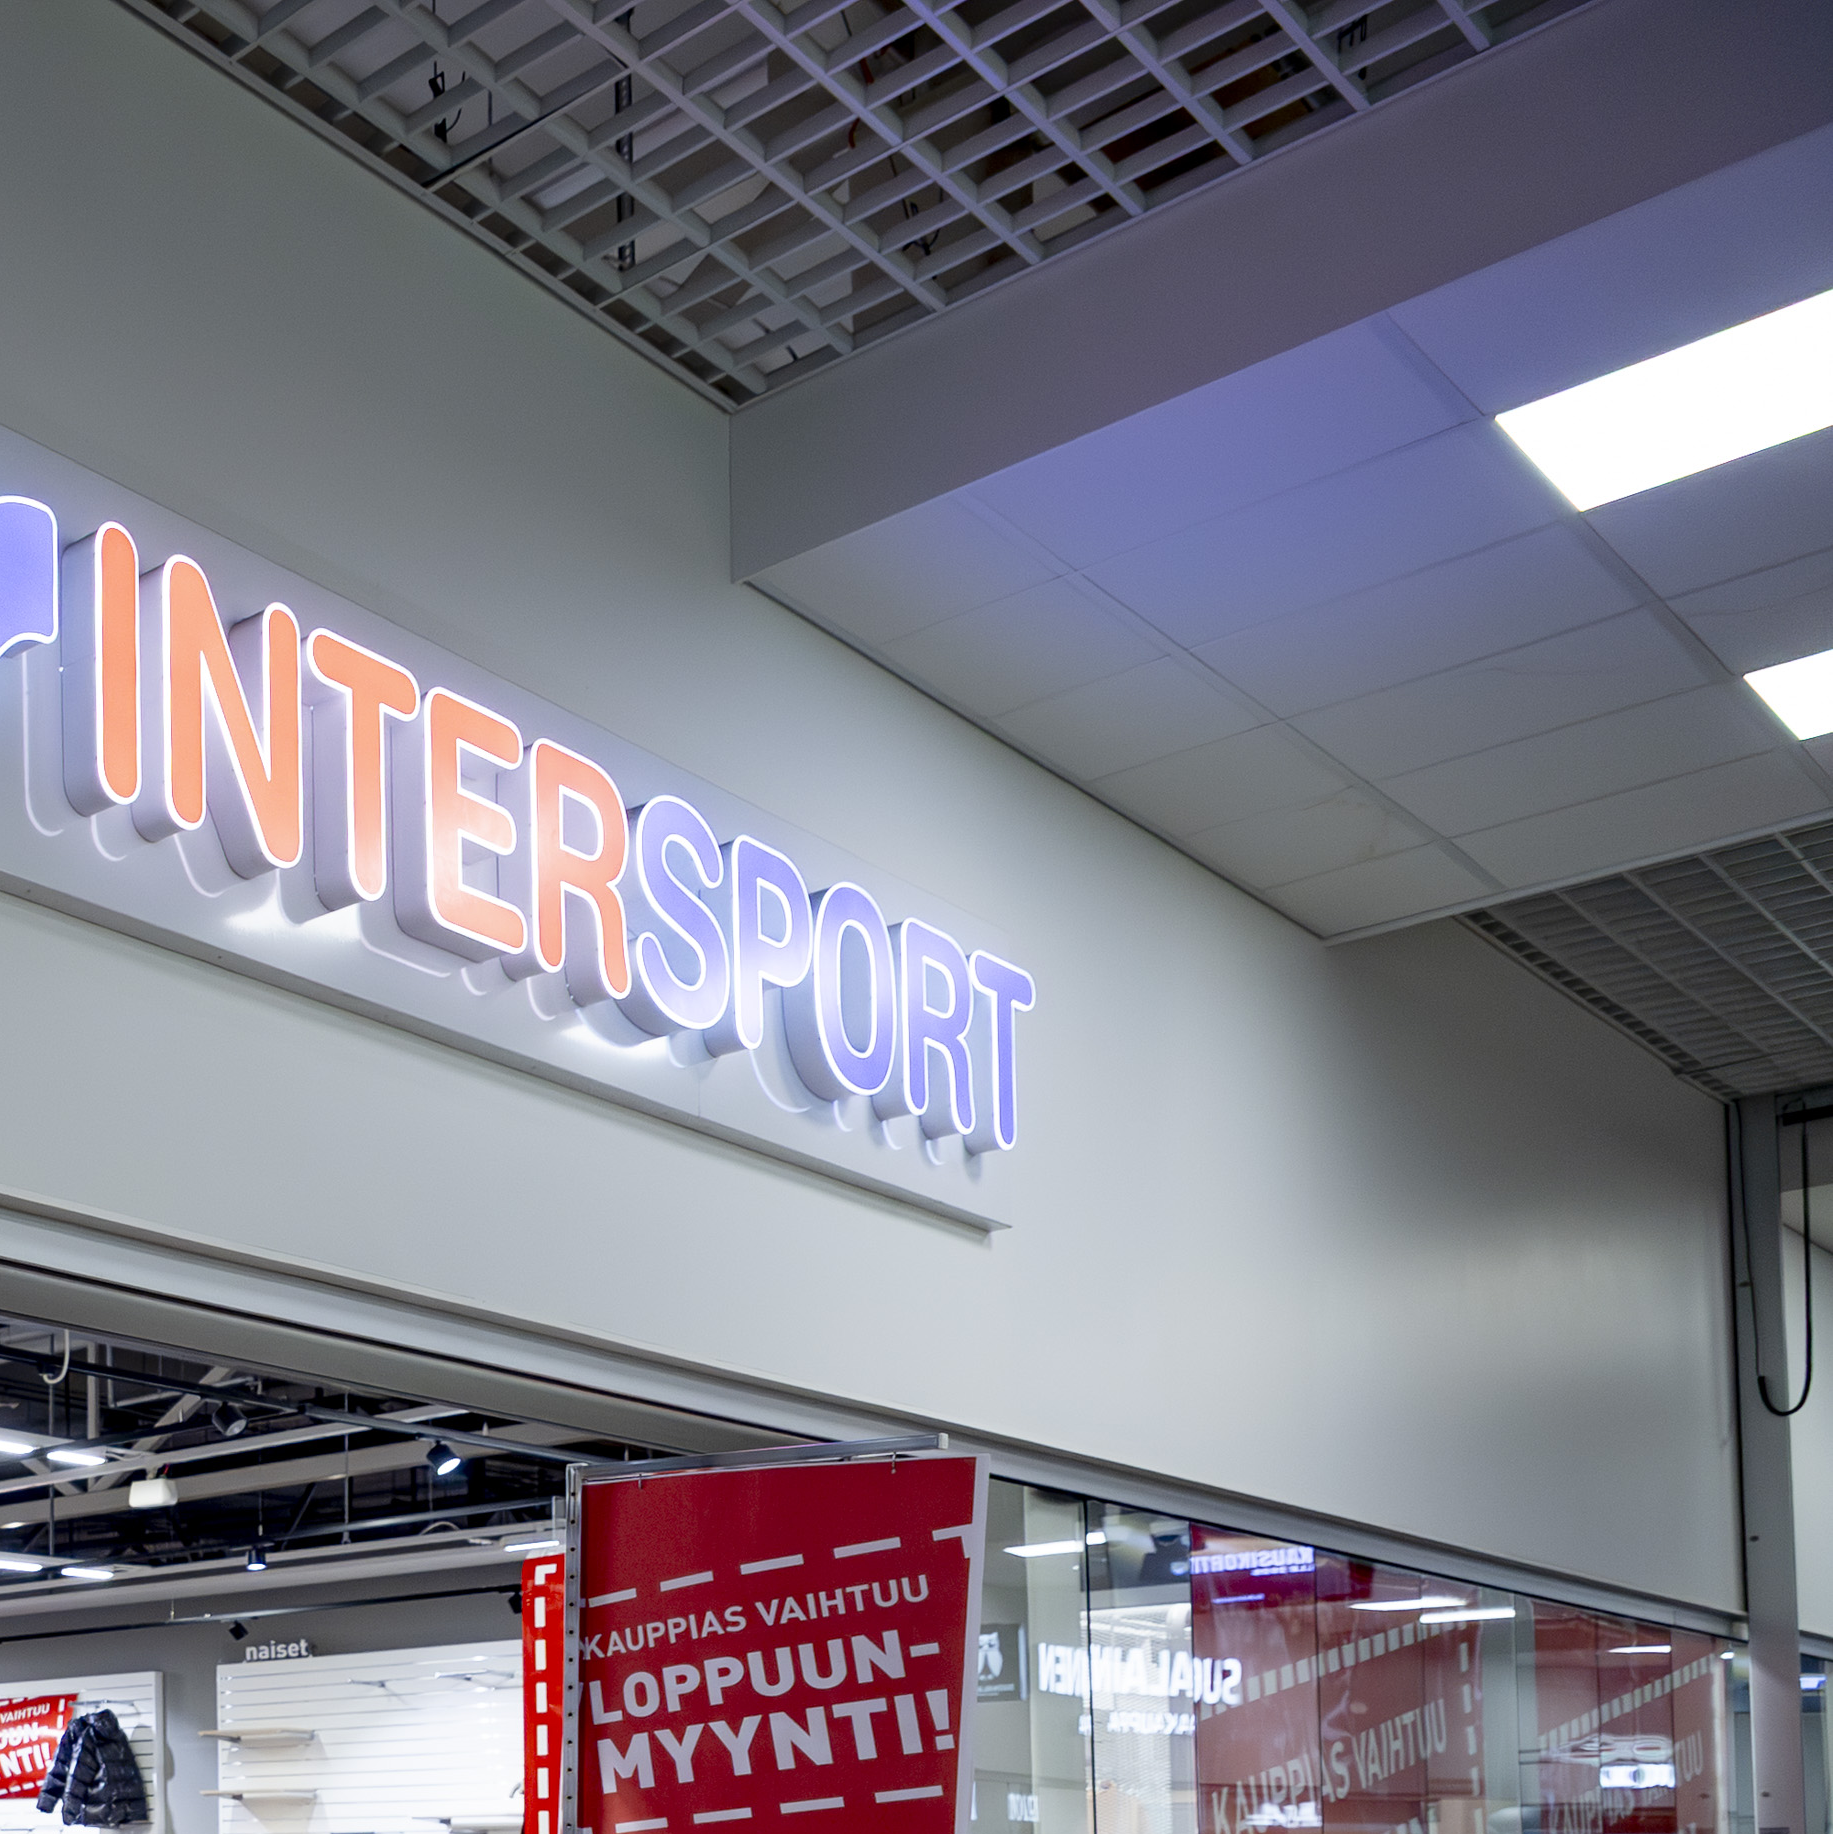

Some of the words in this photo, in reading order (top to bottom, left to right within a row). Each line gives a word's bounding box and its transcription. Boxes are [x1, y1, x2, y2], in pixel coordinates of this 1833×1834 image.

[93, 522, 1035, 1152] INTERSPORT
[245, 1640, 308, 1661] naiset
[581, 1606, 747, 1660] KAUPPIAS
[755, 1575, 930, 1626] VAIHTUU
[0, 1703, 51, 1723] VAIHTUU
[589, 1630, 940, 1725] LOPPUUN-
[597, 1689, 956, 1795] MYYNTI!
[1352, 1698, 1448, 1790] VAIHTUU
